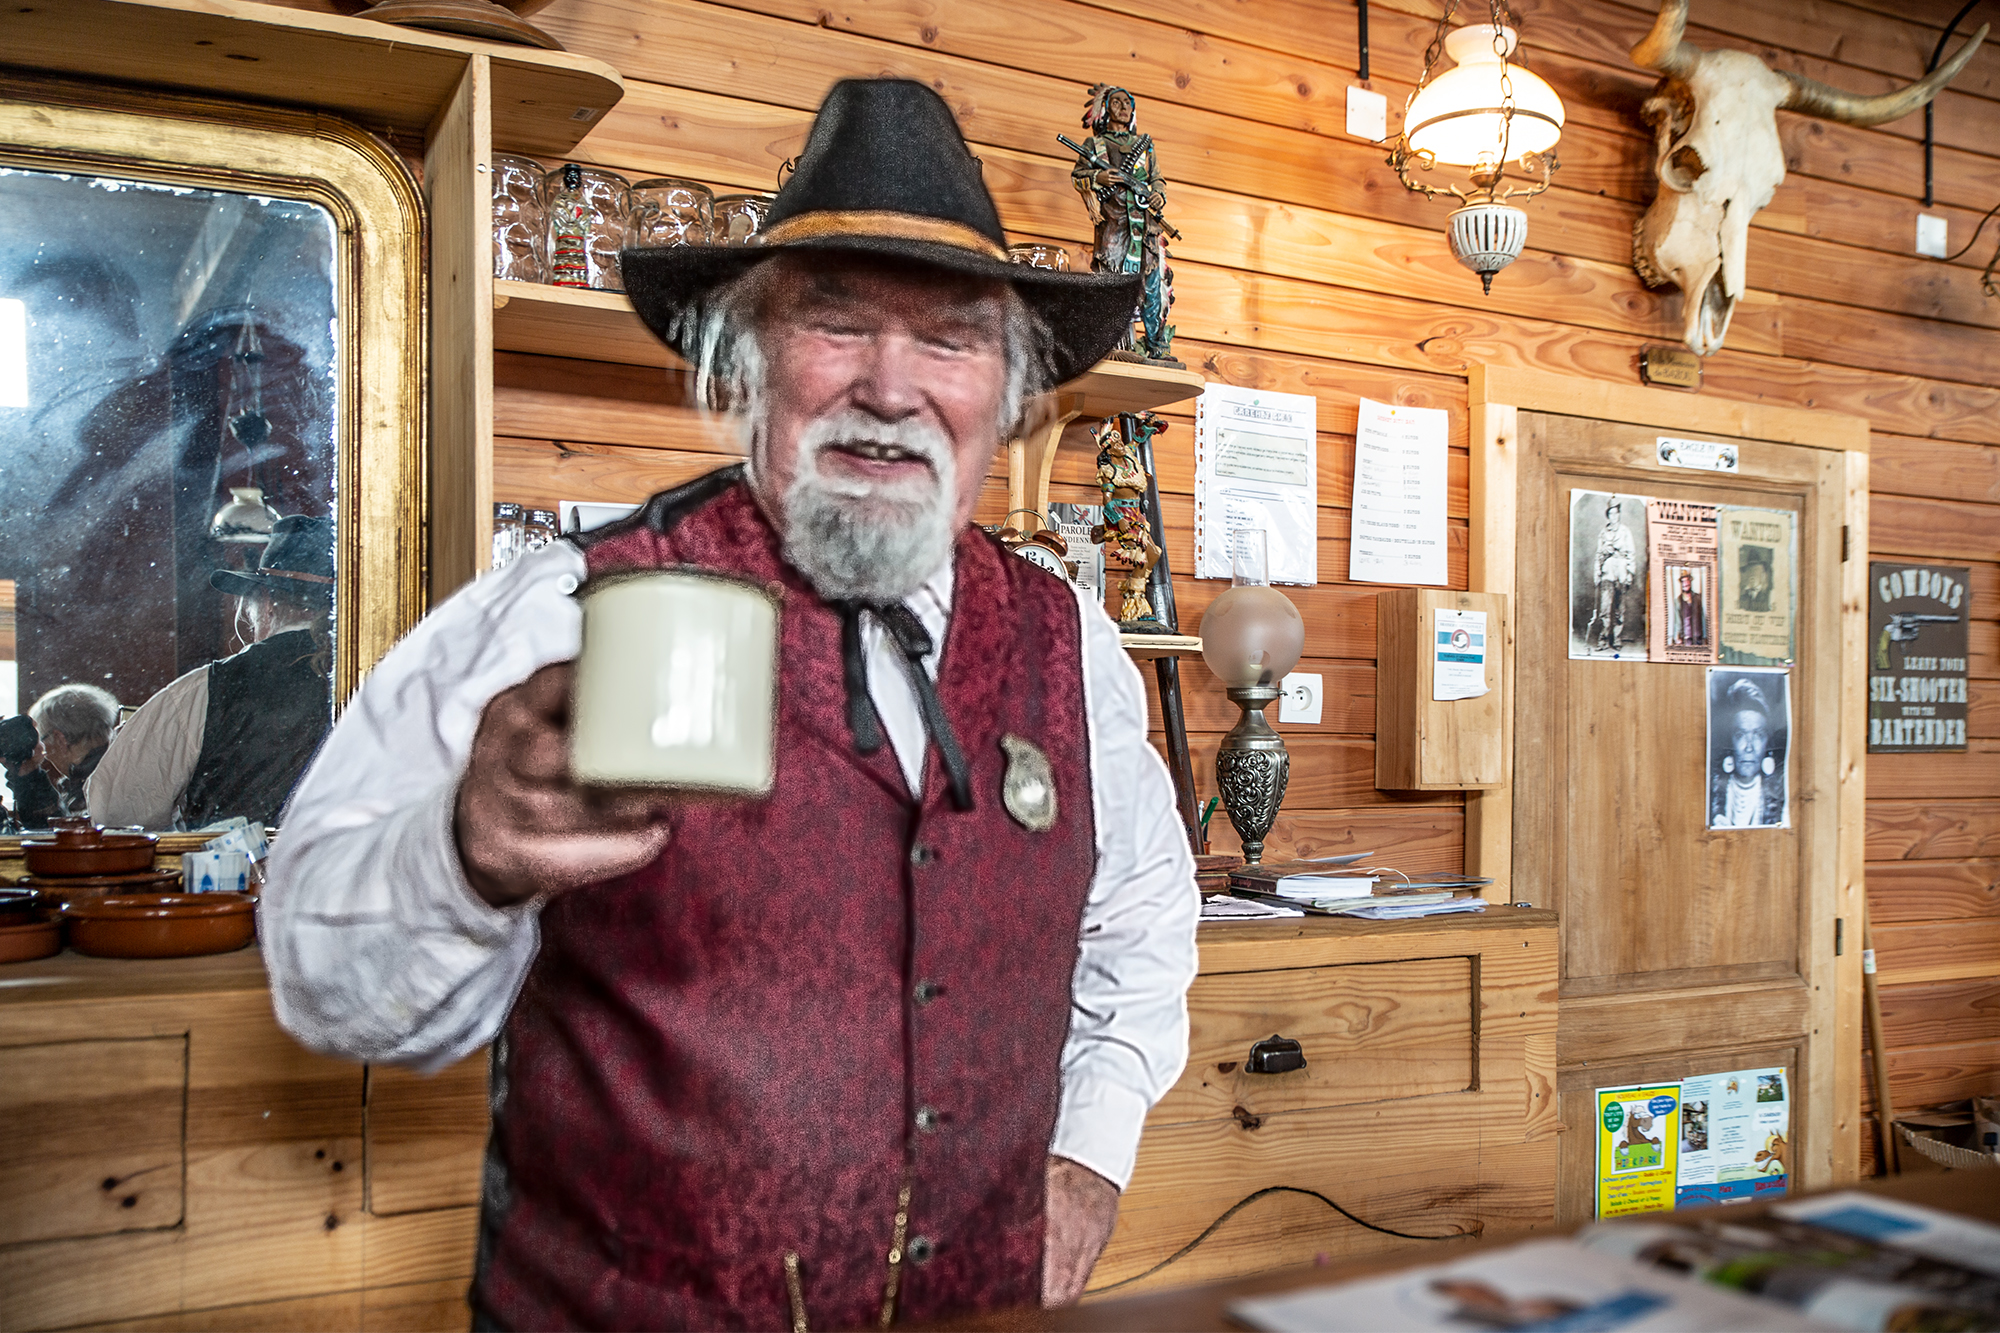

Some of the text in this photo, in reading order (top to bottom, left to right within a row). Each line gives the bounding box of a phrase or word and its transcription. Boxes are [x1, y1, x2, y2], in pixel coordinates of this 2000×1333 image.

[1060, 525, 1092, 536] PAROLE
[1730, 520, 1780, 543] WANTED
[1063, 536, 1092, 544] NDIENN
[1026, 551, 1036, 561] 12
[1041, 557, 1044, 566] 1
[1878, 569, 1964, 609] COWBOYS
[1903, 656, 1967, 672] LEAVE YOUR
[1870, 676, 1968, 703] SIX-SHOOTER
[1901, 706, 1936, 716] WITH THE
[1870, 718, 1967, 746] BARTENDER
[1616, 1155, 1658, 1168] HIPIK PARK
